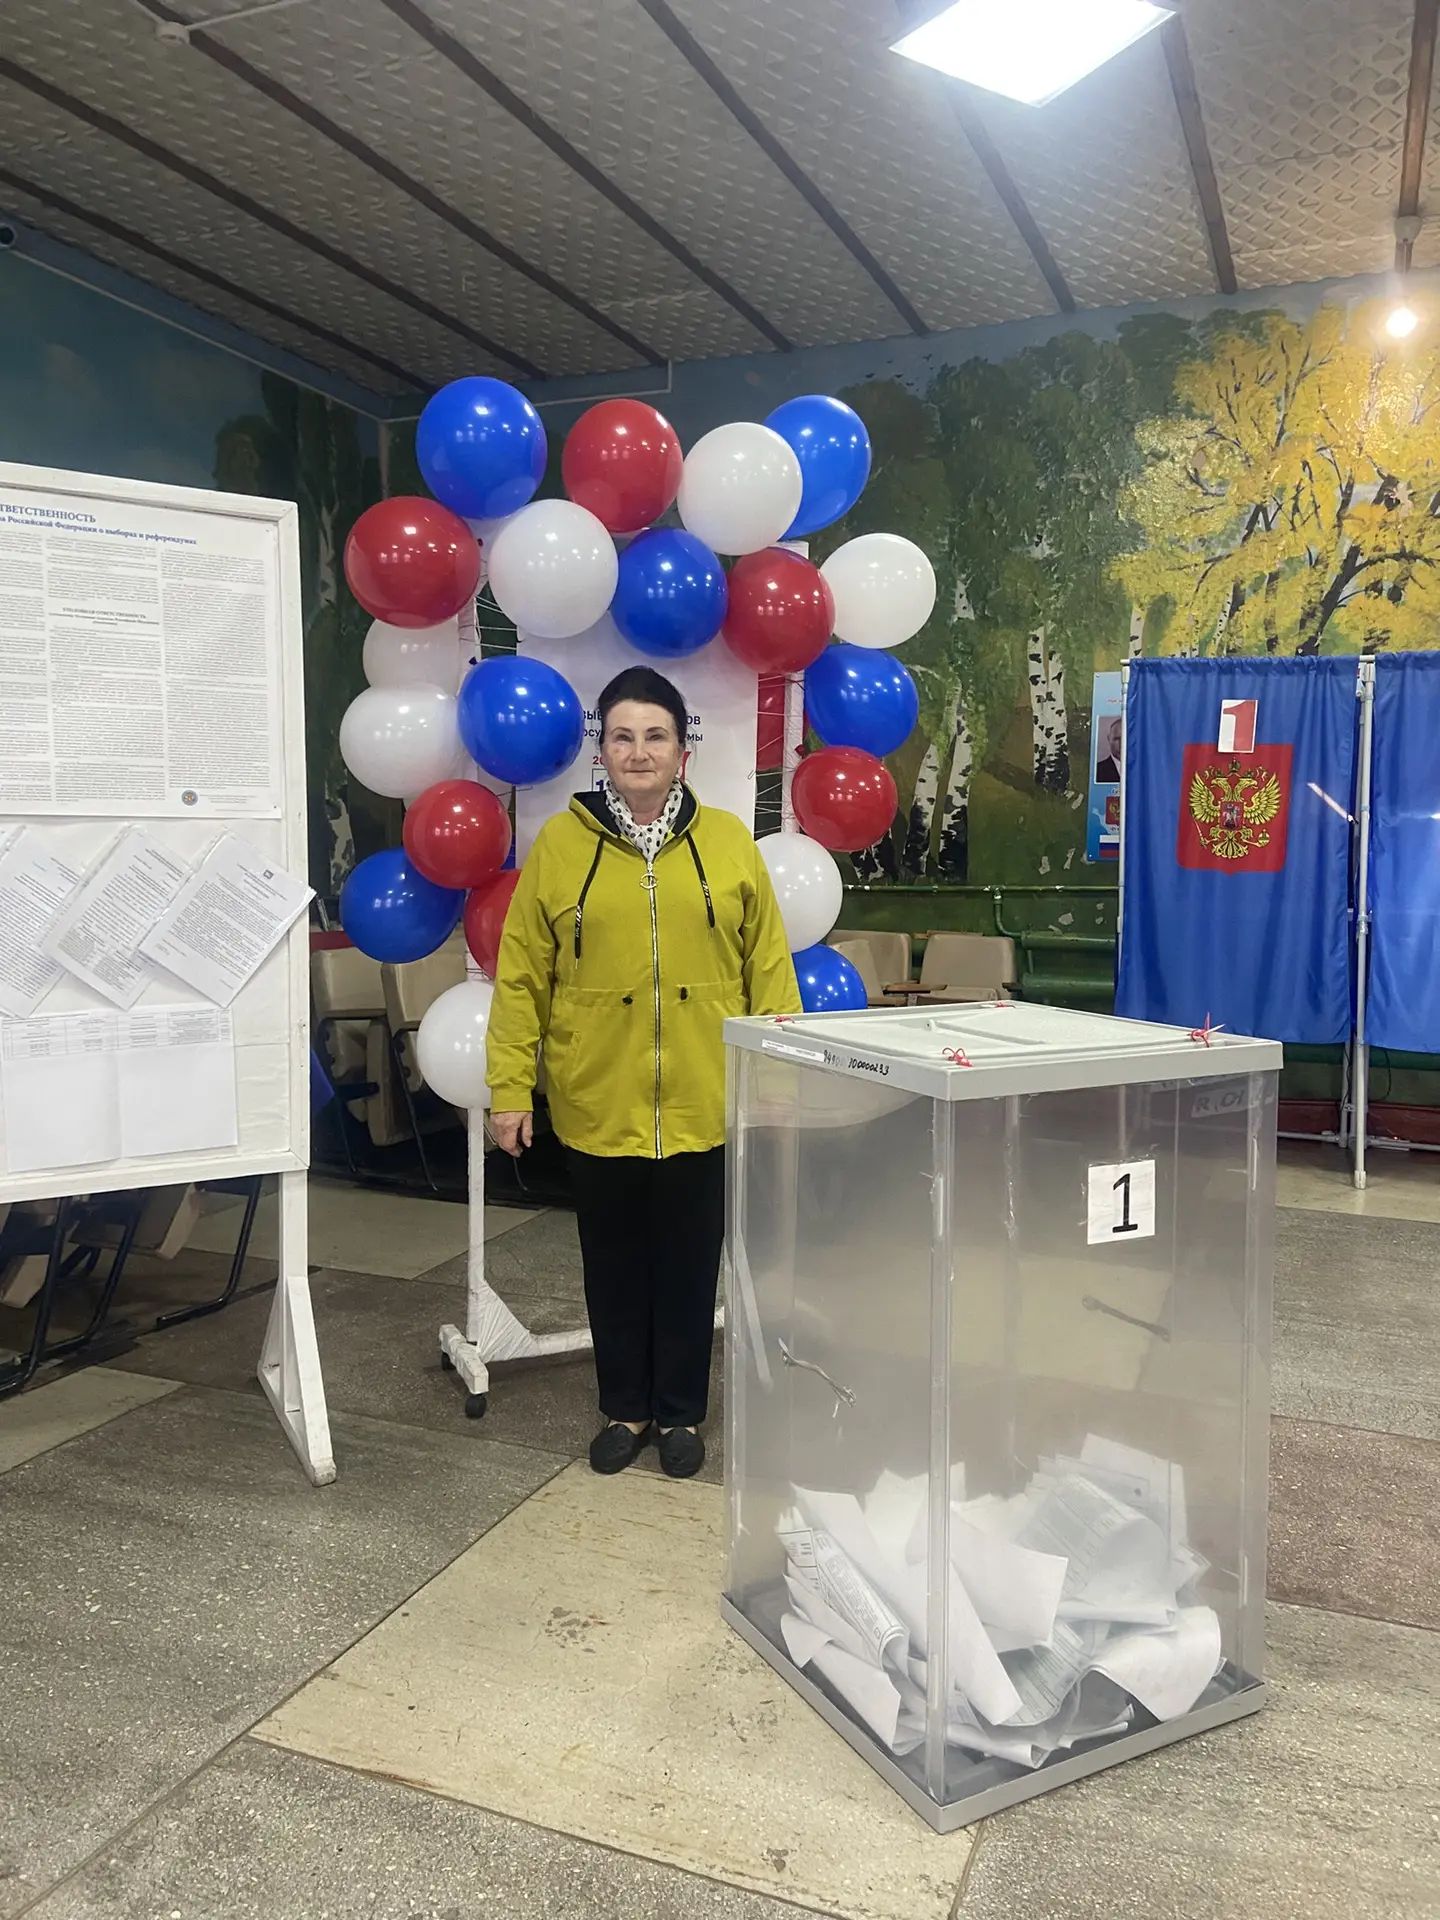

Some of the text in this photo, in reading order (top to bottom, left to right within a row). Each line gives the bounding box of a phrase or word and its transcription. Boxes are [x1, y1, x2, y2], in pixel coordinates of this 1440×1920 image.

[0, 503, 96, 523] ТВЕТСТВЕННОСТЬ
[8, 516, 53, 527] Российской
[55, 521, 97, 533] Федерации
[105, 529, 137, 538] выборах
[145, 533, 197, 545] референдумах
[583, 710, 603, 720] ВЫБ
[1224, 699, 1257, 751] 1
[687, 733, 703, 742] МЫ
[1112, 1173, 1138, 1233] 1
